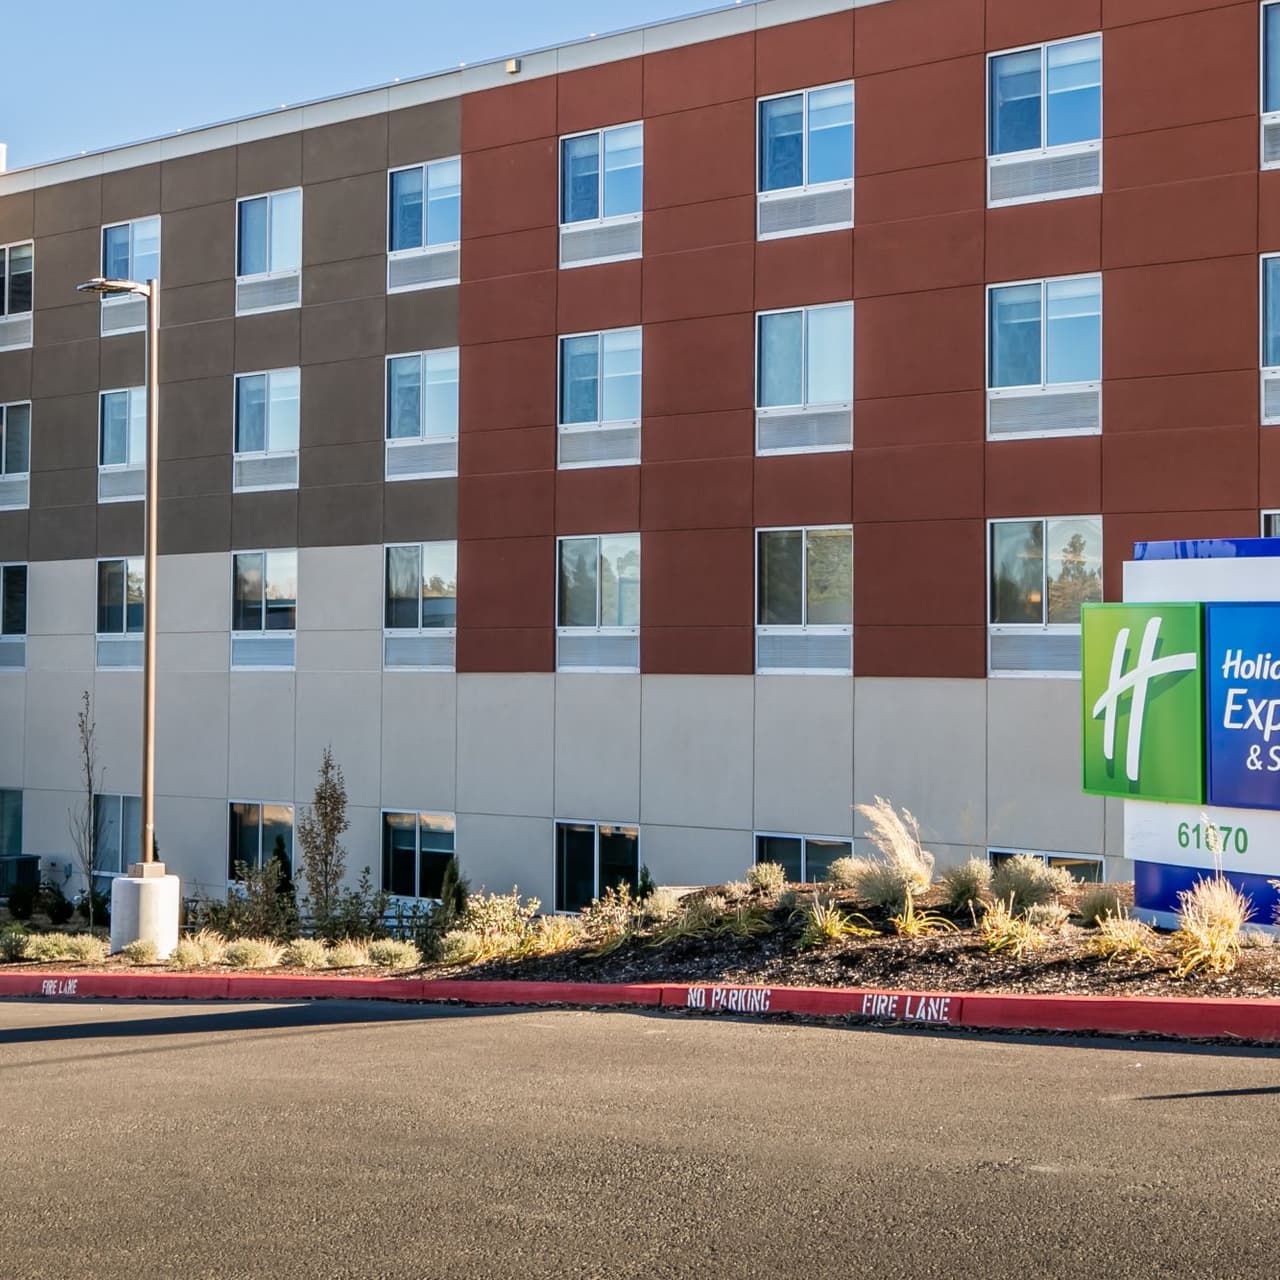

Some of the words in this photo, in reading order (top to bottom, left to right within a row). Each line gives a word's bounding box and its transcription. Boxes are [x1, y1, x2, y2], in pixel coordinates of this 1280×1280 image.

[1246, 744, 1263, 770] &
[42, 979, 57, 995] FIRE
[58, 979, 78, 994] LANE
[687, 987, 706, 1008] NO
[711, 987, 771, 1012] PARKING
[862, 994, 899, 1017] FIRE
[905, 996, 951, 1020] LANE
